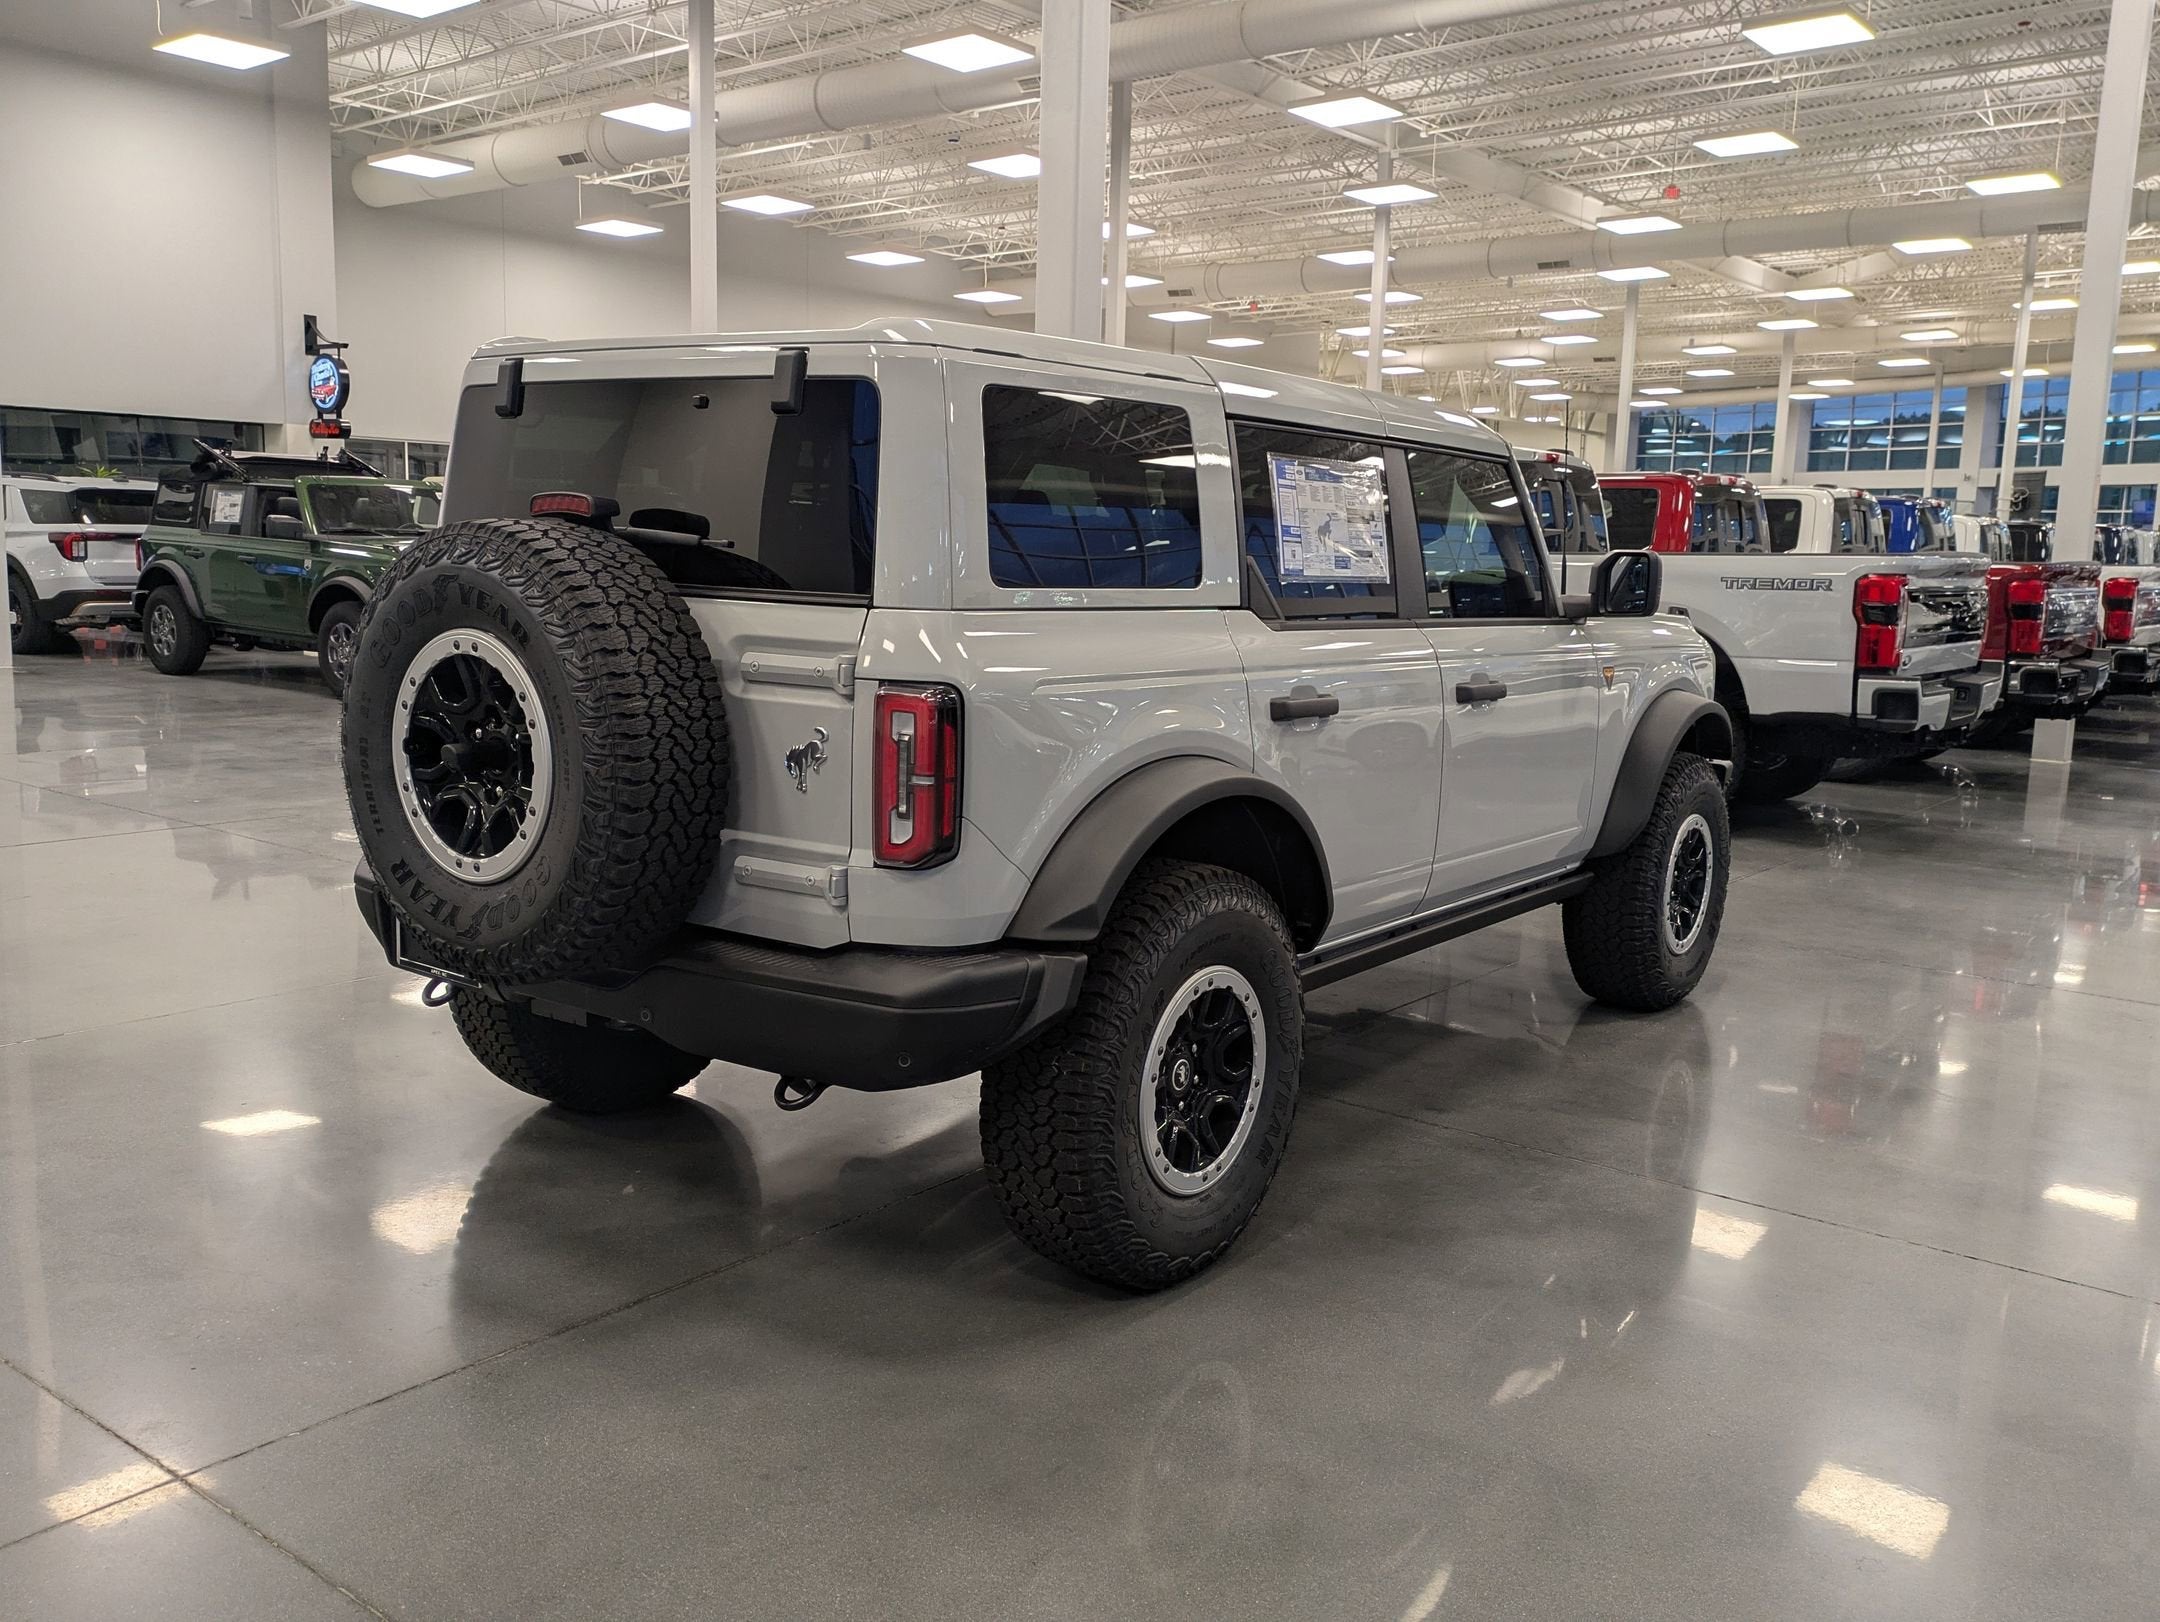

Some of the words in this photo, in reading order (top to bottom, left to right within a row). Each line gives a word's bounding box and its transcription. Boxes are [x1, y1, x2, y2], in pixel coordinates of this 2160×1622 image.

[370, 574, 531, 668] GOODYEAR
[1721, 577, 1833, 591] TREMOR
[390, 856, 551, 942] GOODYEAR
